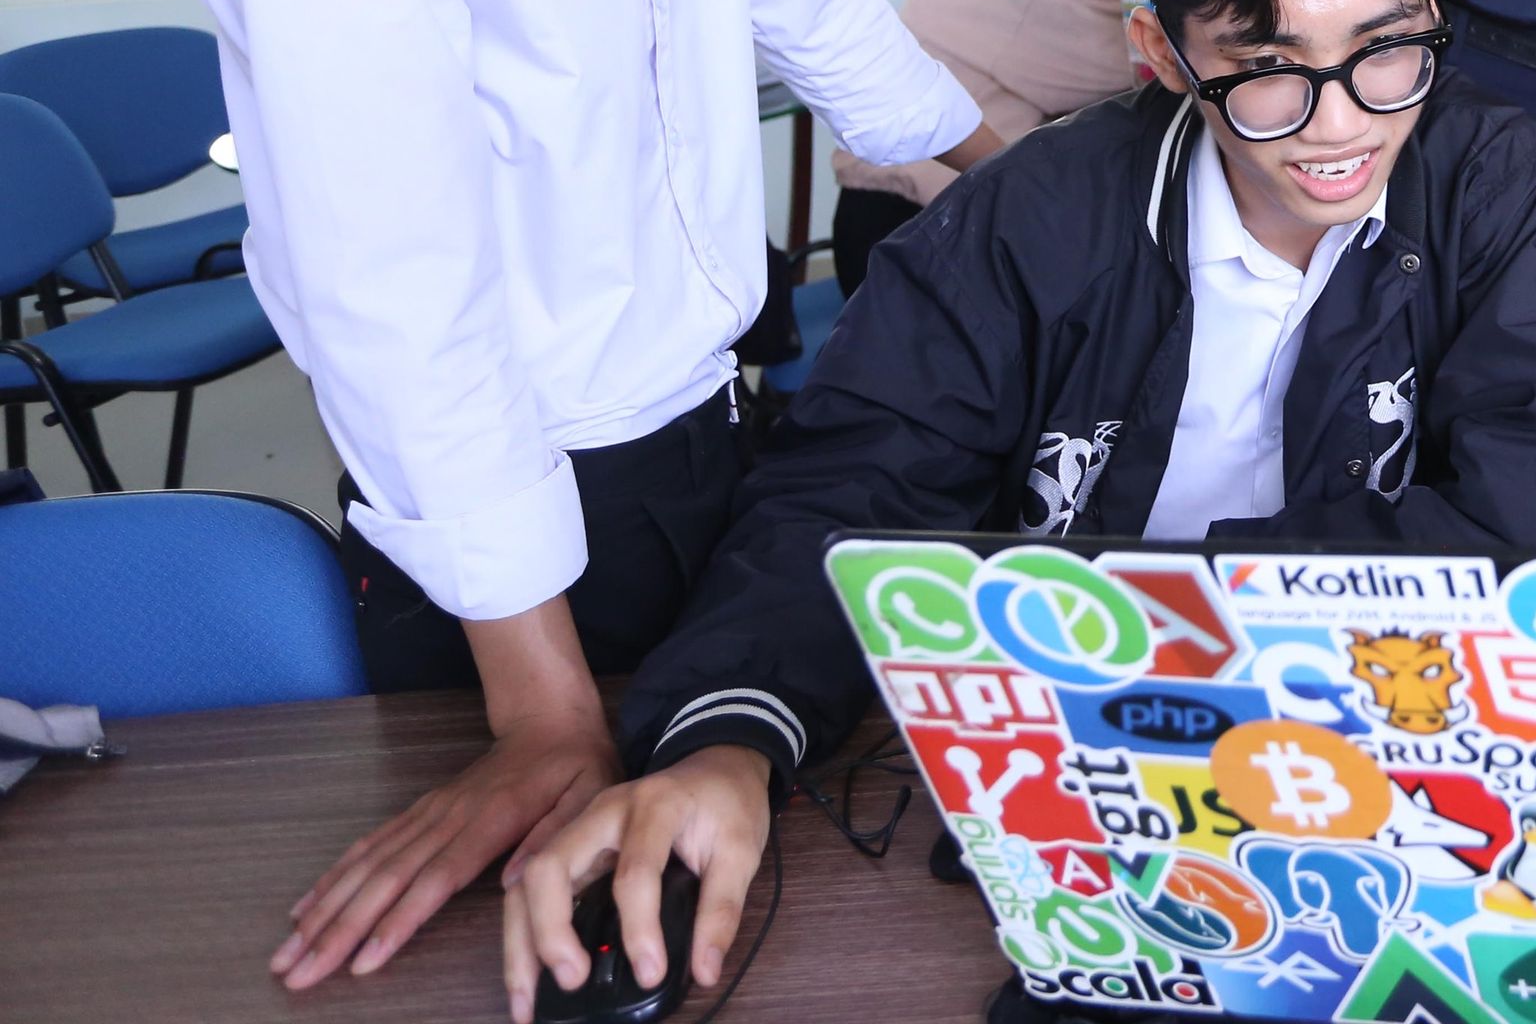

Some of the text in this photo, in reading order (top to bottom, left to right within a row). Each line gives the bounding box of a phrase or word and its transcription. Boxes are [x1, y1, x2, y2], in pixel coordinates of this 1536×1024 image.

[1279, 564, 1486, 599] Kotlin 1.1
[1121, 698, 1217, 737] php
[1065, 750, 1172, 845] git
[1170, 785, 1256, 837] JS
[957, 816, 1028, 921] spring
